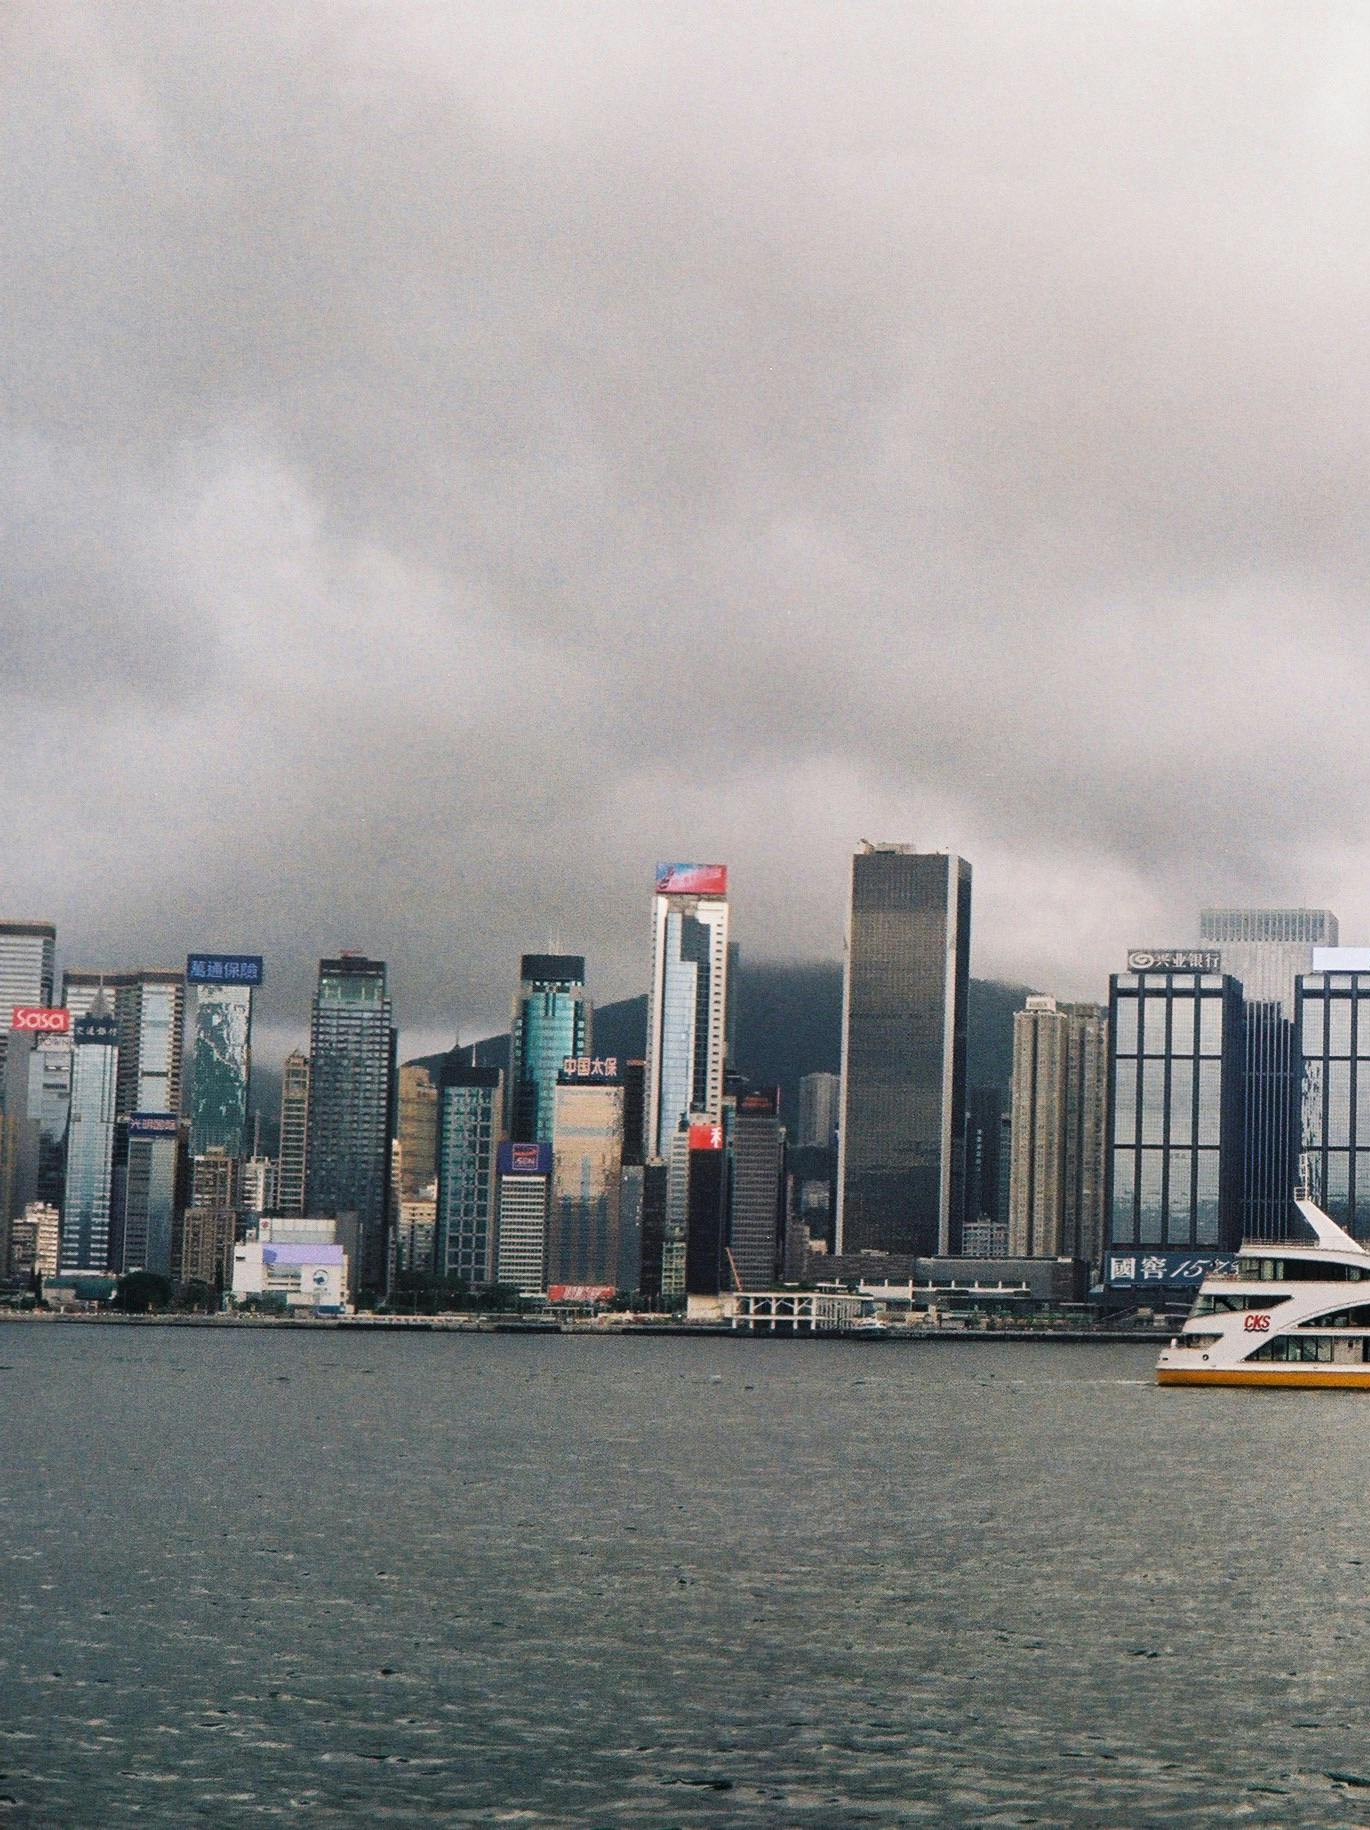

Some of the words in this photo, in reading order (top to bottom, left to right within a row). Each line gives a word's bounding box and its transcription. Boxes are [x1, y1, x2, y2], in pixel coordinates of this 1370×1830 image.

[1154, 952, 1219, 968] 兴业银行
[191, 960, 258, 979] 萬通保險
[563, 1056, 618, 1077] 中国太保
[1244, 1314, 1271, 1328] CKS
